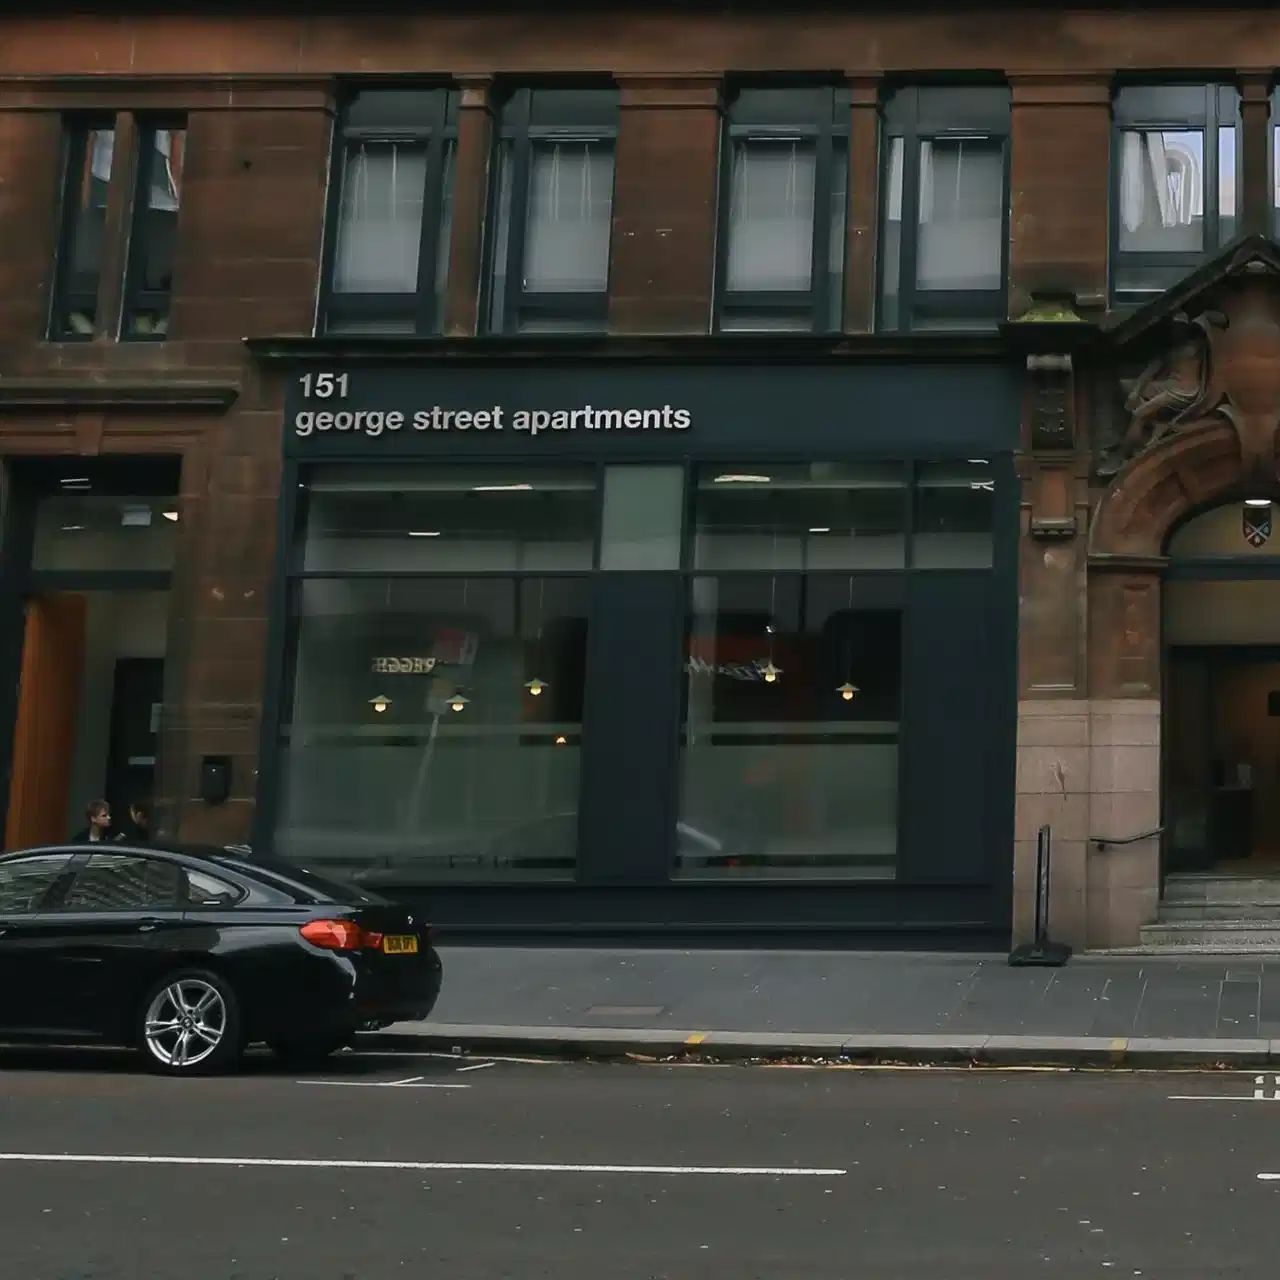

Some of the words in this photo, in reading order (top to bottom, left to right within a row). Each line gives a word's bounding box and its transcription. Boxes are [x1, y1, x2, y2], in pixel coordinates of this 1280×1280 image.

[299, 372, 349, 398] 151
[295, 409, 405, 437] george
[412, 405, 504, 430] street
[512, 404, 691, 435] apartments
